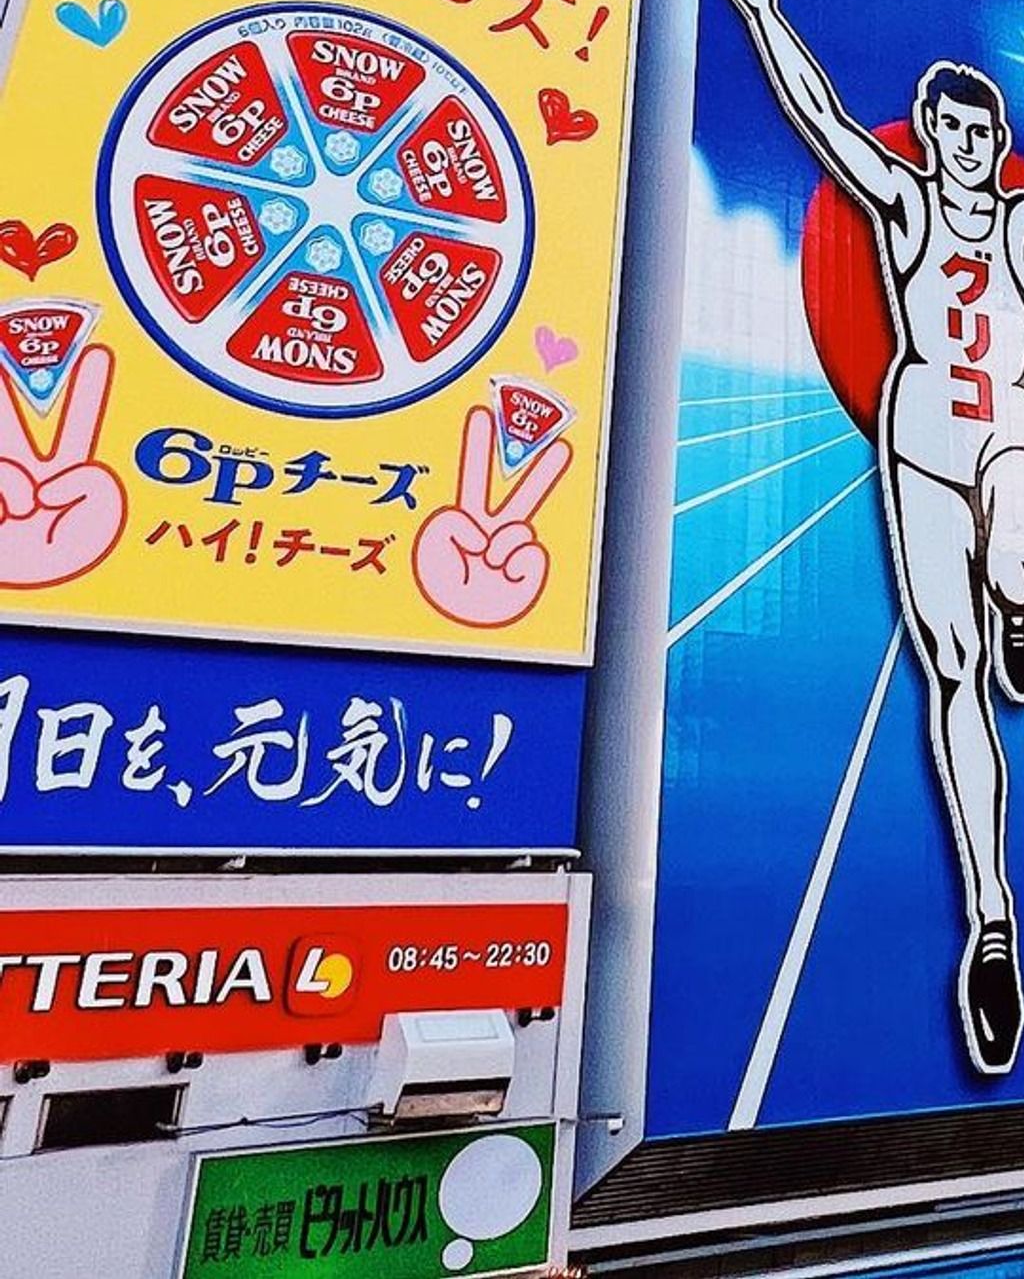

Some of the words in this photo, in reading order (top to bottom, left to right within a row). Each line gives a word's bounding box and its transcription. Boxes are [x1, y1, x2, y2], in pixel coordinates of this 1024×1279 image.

[311, 40, 405, 81] SNOW
[169, 54, 248, 133] SNOW
[319, 105, 377, 129] CHEESE
[238, 116, 284, 161] CHEESE
[447, 120, 499, 202] SNOW
[402, 150, 432, 202] CHEESE
[144, 200, 204, 294] SNOW
[227, 197, 258, 255] CHEESE
[8, 315, 70, 334] SNOW
[421, 262, 486, 346] SNOW
[252, 334, 357, 374] SNOW
[940, 250, 994, 422] グリコ
[510, 391, 554, 418] SNOW
[202, 1199, 296, 1264] 賃貸・売買
[300, 1174, 428, 1260] ピタットハウス
